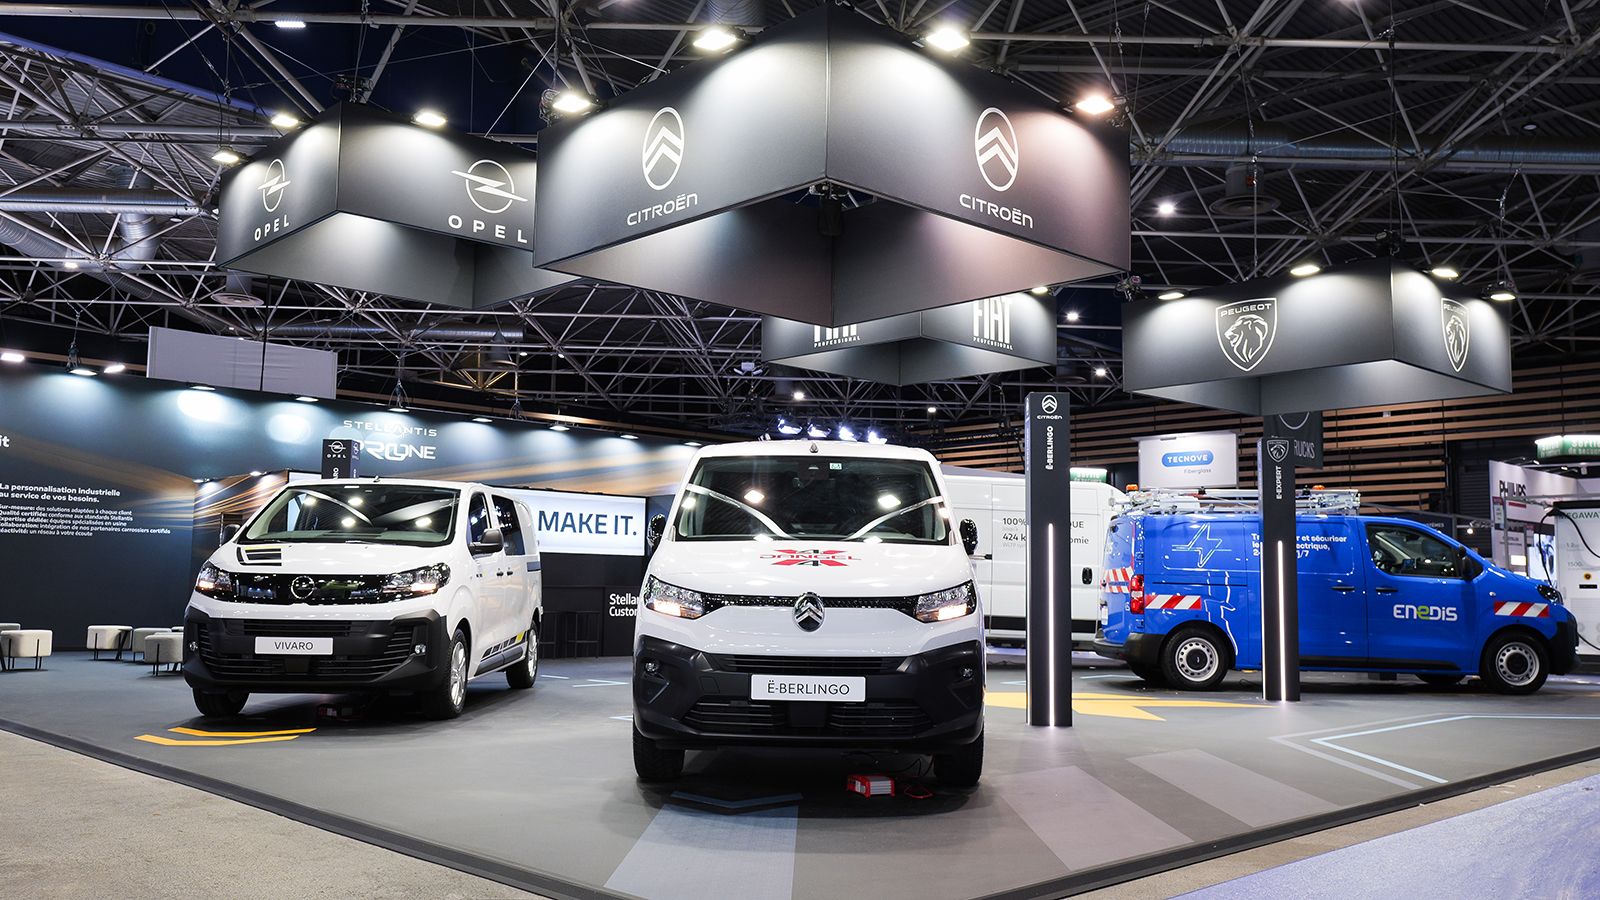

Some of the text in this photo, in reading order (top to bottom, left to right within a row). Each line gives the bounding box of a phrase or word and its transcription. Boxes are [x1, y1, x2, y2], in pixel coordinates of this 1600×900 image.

[627, 193, 698, 226] CITROËN
[959, 193, 1034, 229] CITROËN
[254, 214, 290, 241] OPEL
[448, 214, 528, 244] OPEL
[1220, 303, 1272, 317] PEUGEOT
[1167, 455, 1208, 463] TECNOVE
[11, 484, 77, 494] personnalisation
[68, 494, 100, 502] besoins.
[39, 522, 71, 530] intégration
[72, 518, 104, 526] spécialisées
[538, 510, 637, 536] MAKE IT.
[1070, 521, 1084, 529] UE
[1003, 533, 1018, 541] 424
[1311, 534, 1347, 542] sécuriser
[274, 641, 314, 651] VIVARO
[767, 679, 850, 696] Ë-BERLINGO
